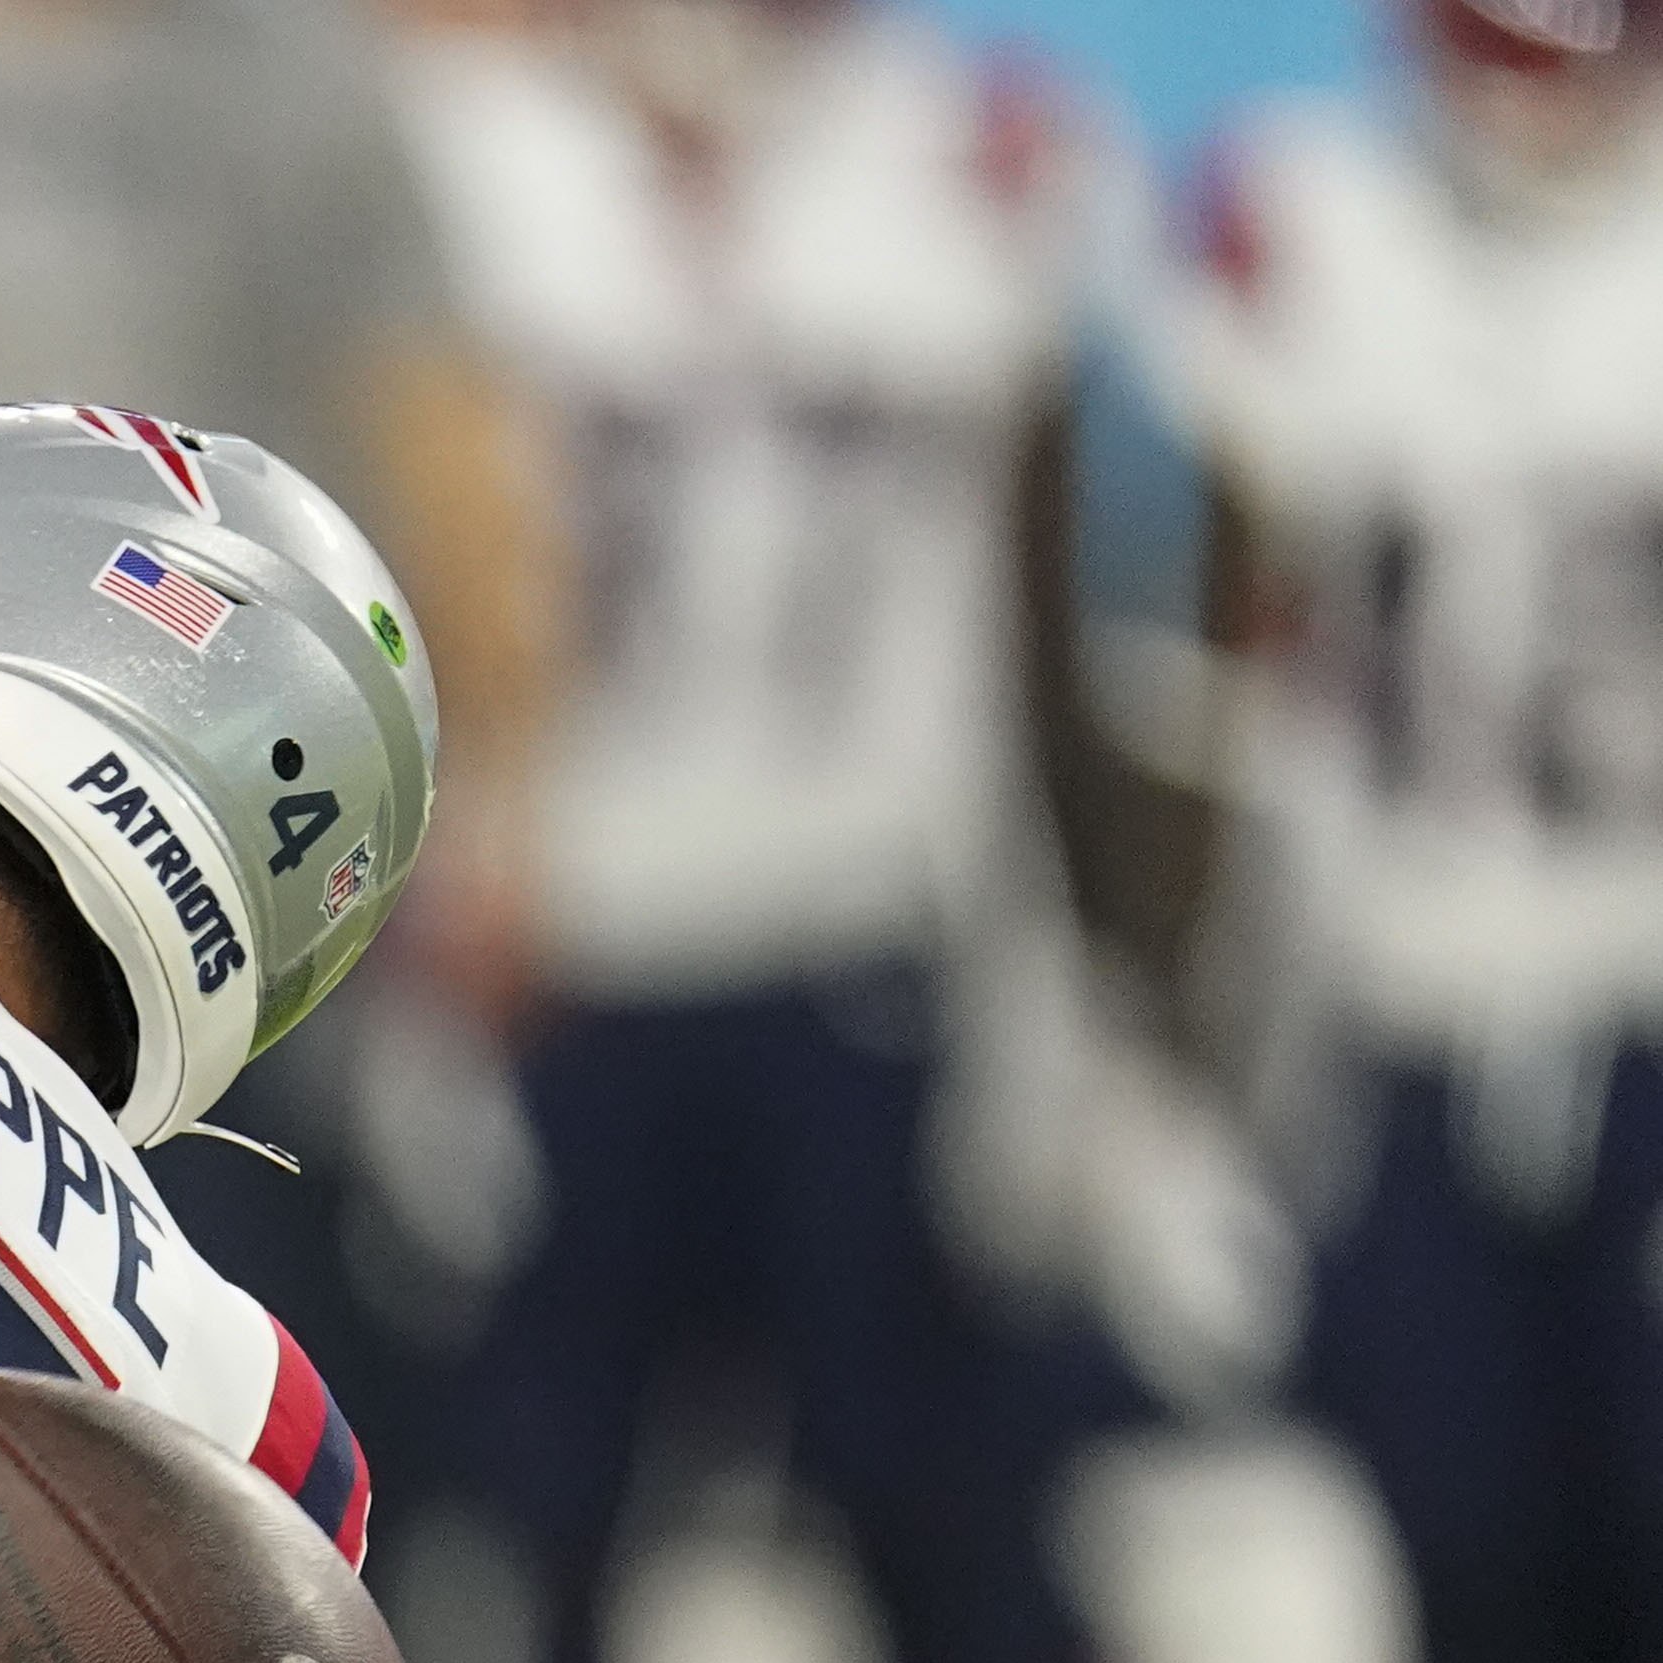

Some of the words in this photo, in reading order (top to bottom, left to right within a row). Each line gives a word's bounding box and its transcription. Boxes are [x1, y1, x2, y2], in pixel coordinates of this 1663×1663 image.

[68, 752, 246, 994] PATRIOTS
[268, 790, 341, 878] 4
[328, 860, 354, 915] NFL
